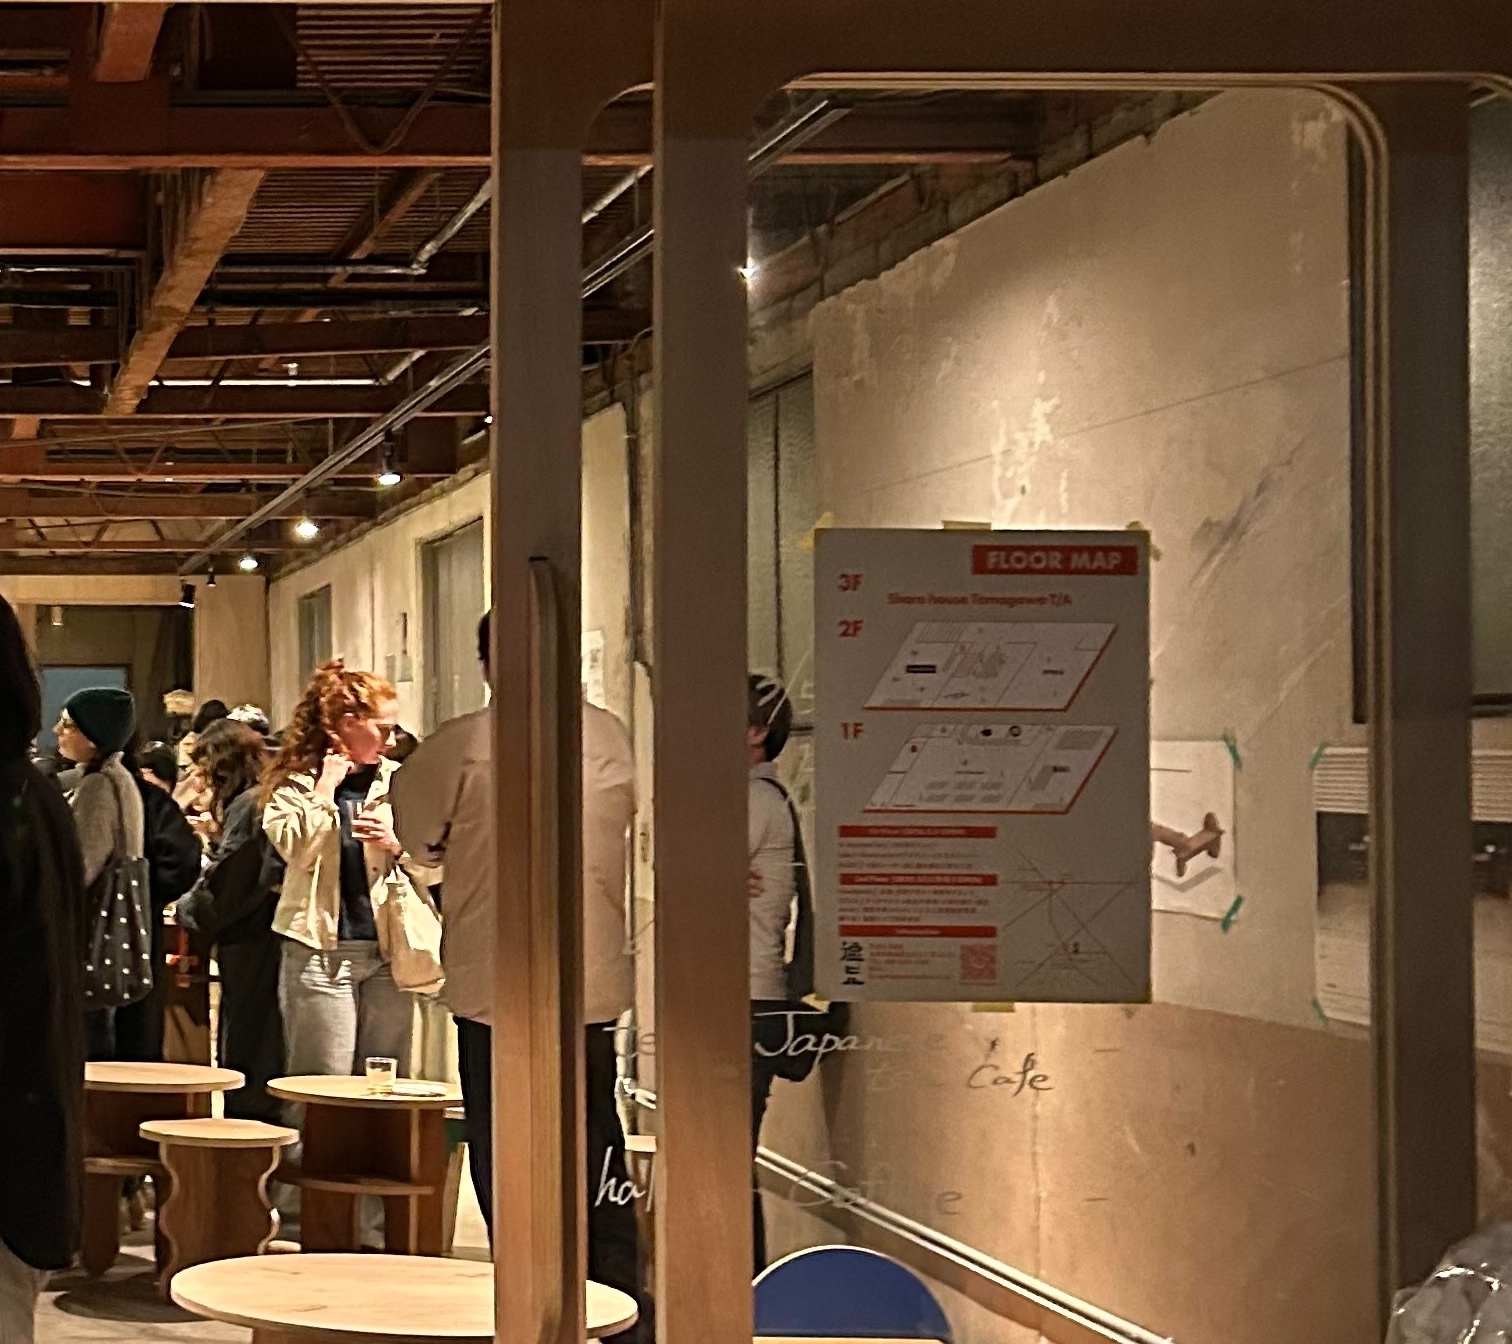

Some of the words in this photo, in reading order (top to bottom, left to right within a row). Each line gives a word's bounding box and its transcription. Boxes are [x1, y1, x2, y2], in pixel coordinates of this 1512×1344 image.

[986, 550, 1063, 570] FLOOR
[1070, 550, 1123, 571] MAP
[837, 573, 863, 593] 3F
[838, 620, 863, 638] 2F
[840, 723, 864, 740] 1F
